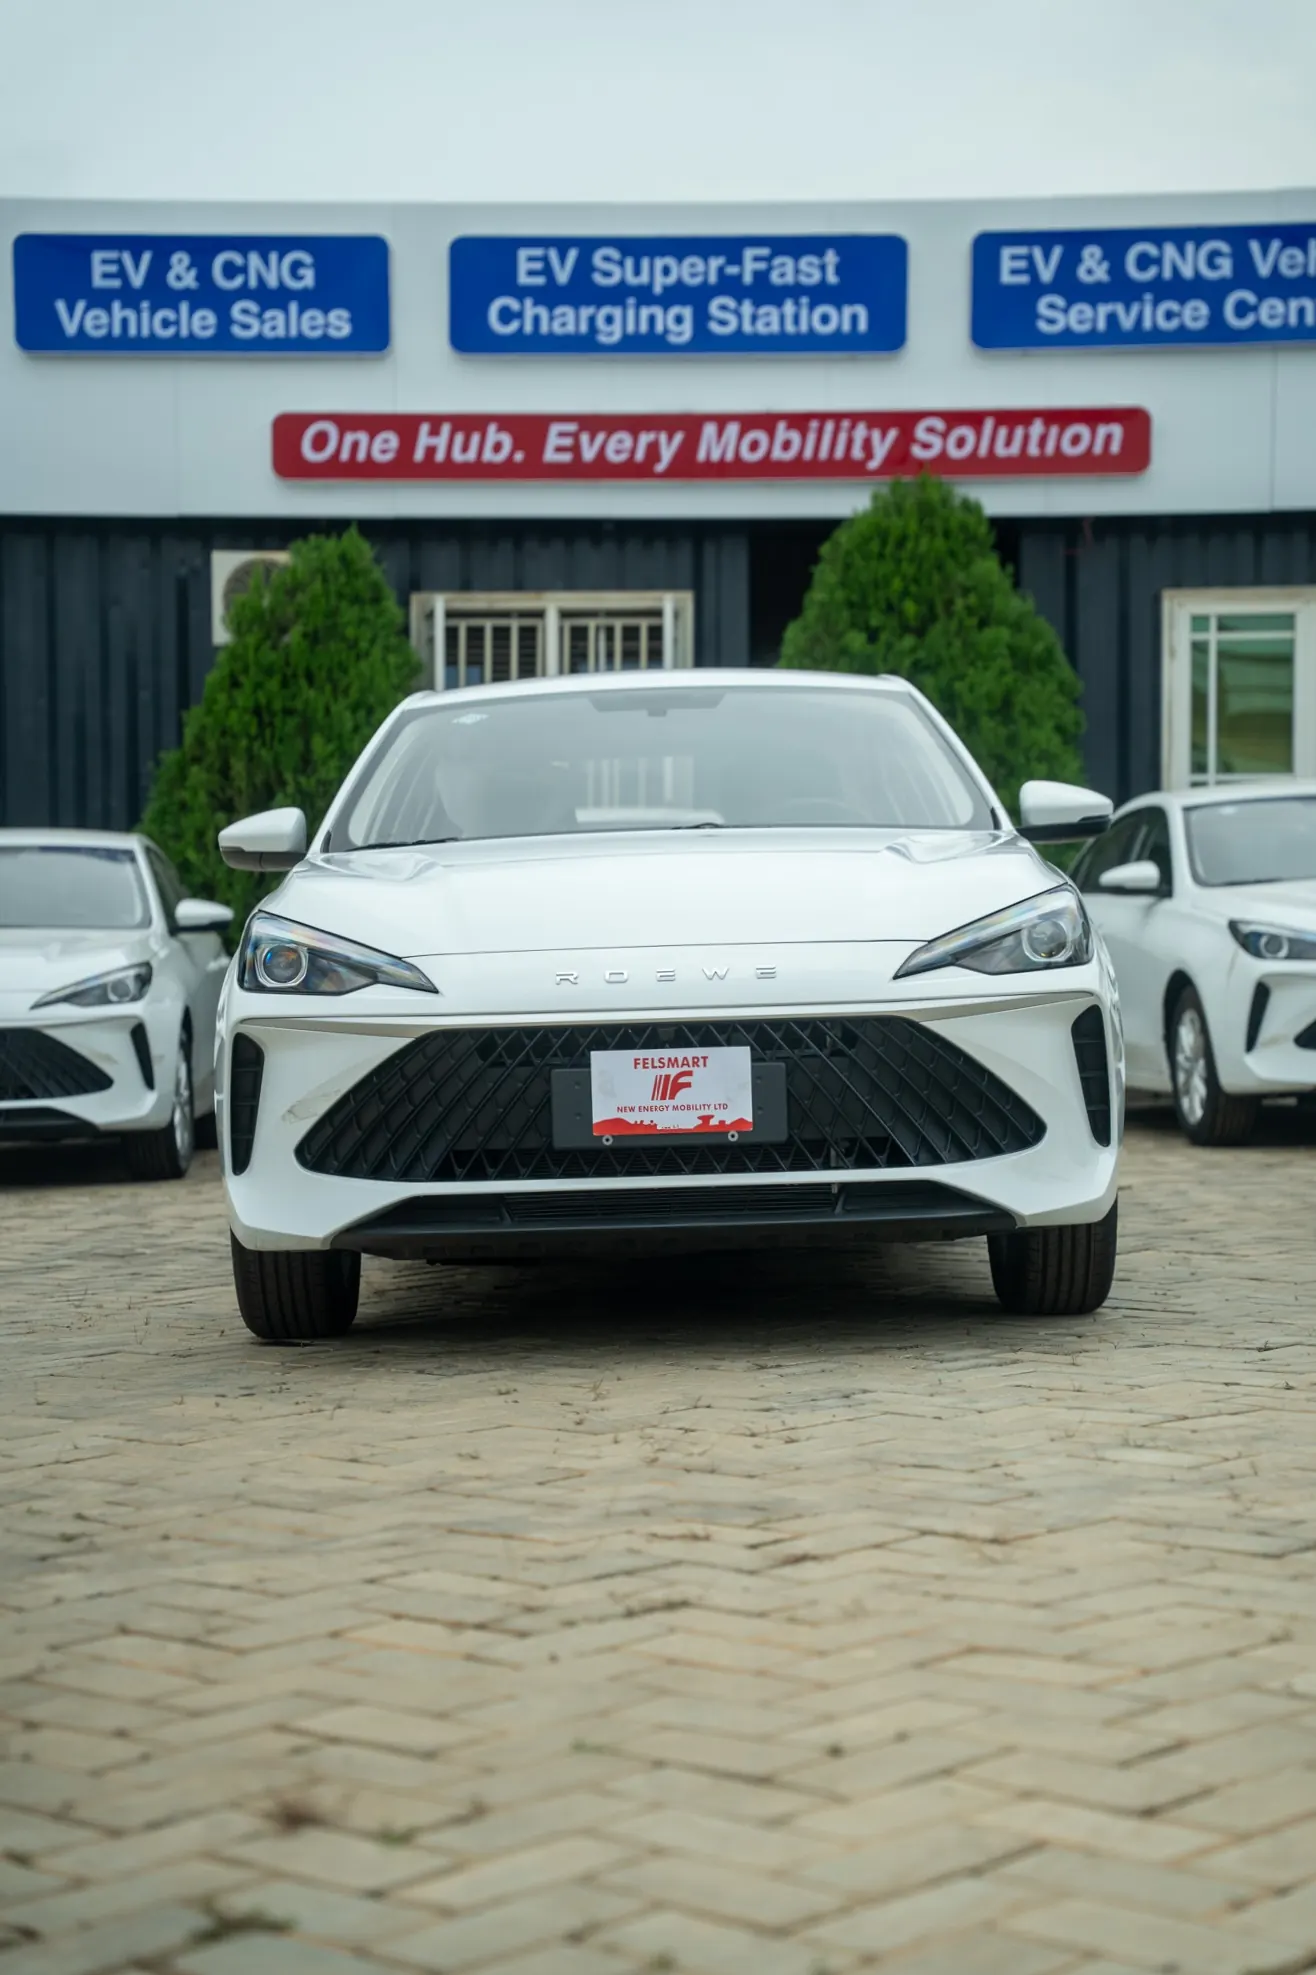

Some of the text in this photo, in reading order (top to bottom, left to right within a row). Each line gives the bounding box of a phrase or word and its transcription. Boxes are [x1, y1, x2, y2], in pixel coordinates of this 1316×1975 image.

[90, 249, 316, 291] EV & CNG
[516, 246, 840, 295] EV Super-Fast
[999, 245, 1064, 285] EV
[1076, 243, 1111, 283] &
[1124, 239, 1233, 282] CNG
[54, 299, 353, 340] Vehicle Sales
[487, 295, 869, 345] Charging Station
[1035, 292, 1210, 334] Service
[300, 415, 1124, 474] One Hub. Every Mobility Solution
[555, 964, 777, 985] ROEWE
[633, 1056, 709, 1069] FELSMART
